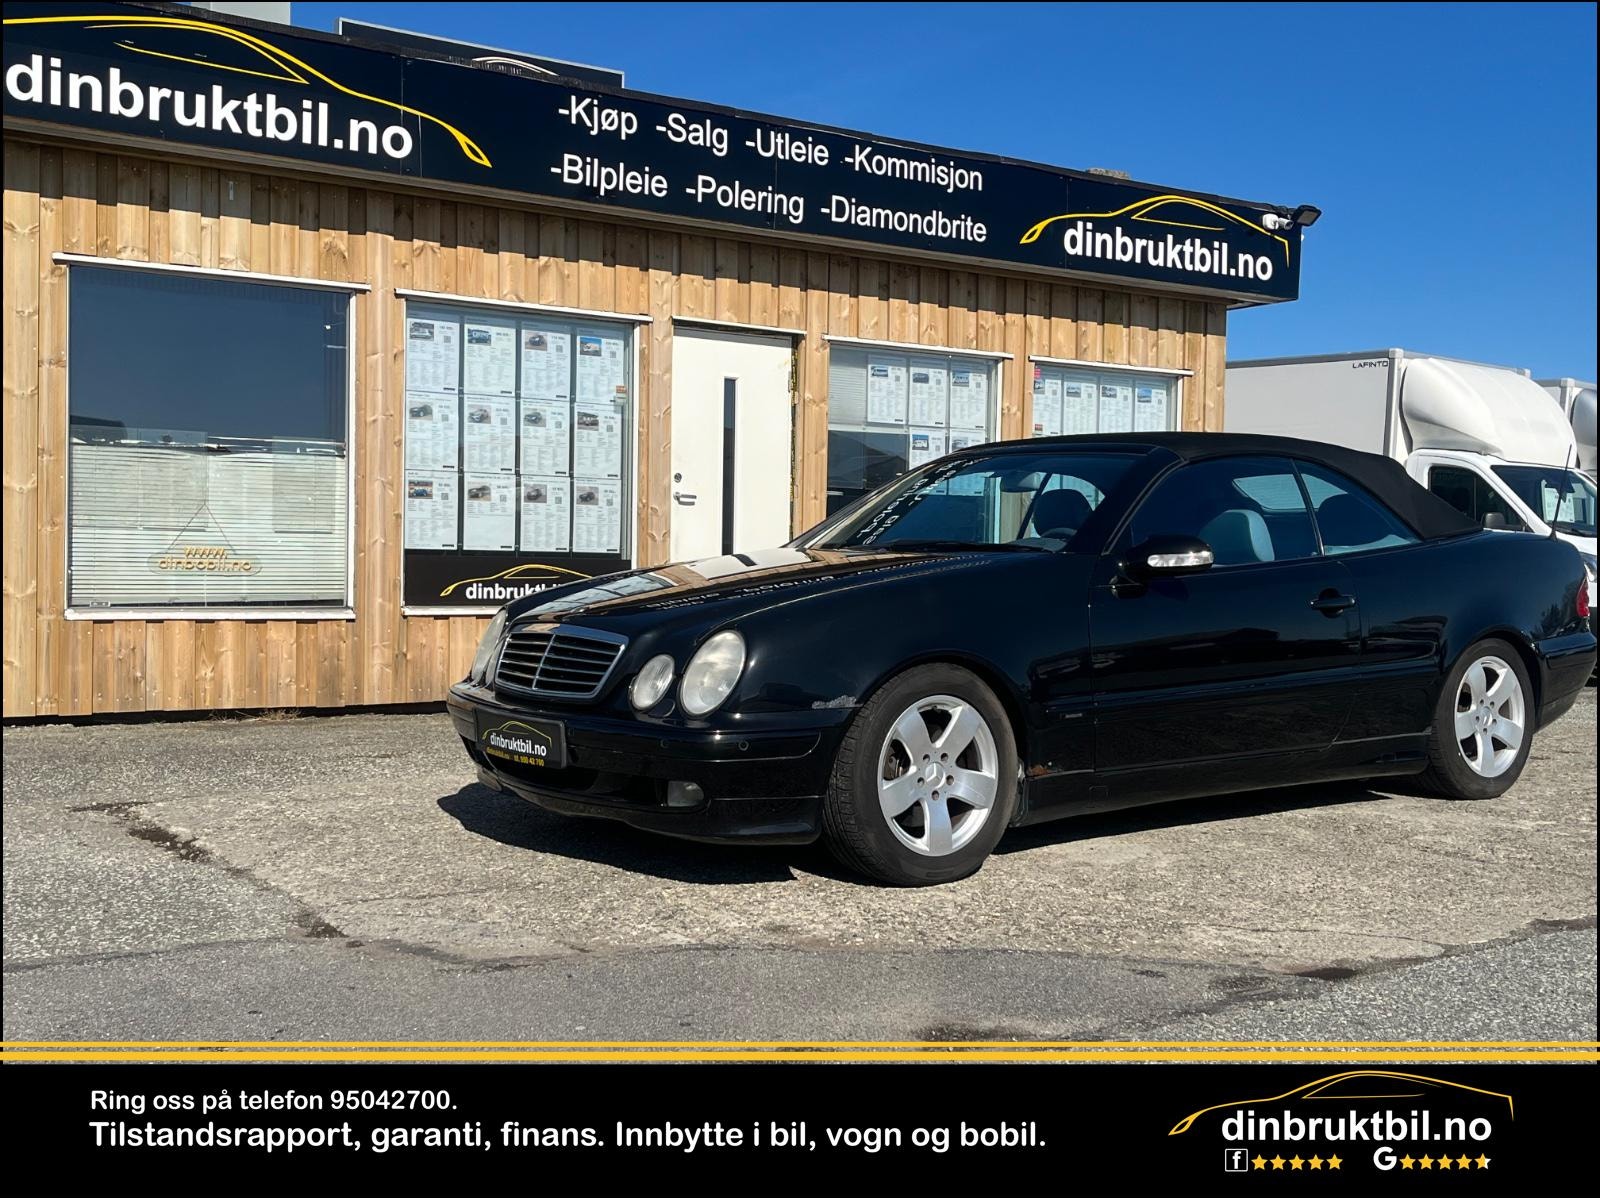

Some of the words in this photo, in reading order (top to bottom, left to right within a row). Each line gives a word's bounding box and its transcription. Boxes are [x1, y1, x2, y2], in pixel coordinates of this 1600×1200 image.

[5, 54, 413, 159] dinbruktbil.no
[558, 95, 638, 140] -Kjøp
[656, 113, 728, 157] -Salg
[745, 128, 829, 166] -Utleie
[844, 146, 984, 193] -Kommisjon
[550, 153, 668, 197] -Bilpleie
[685, 174, 804, 223] -Polering
[821, 195, 988, 243] -Diamondbrite
[1063, 221, 1273, 281] dinbruktbil.no
[1352, 360, 1388, 369] LAFINTO
[490, 732, 547, 756] dinbruktbil.no
